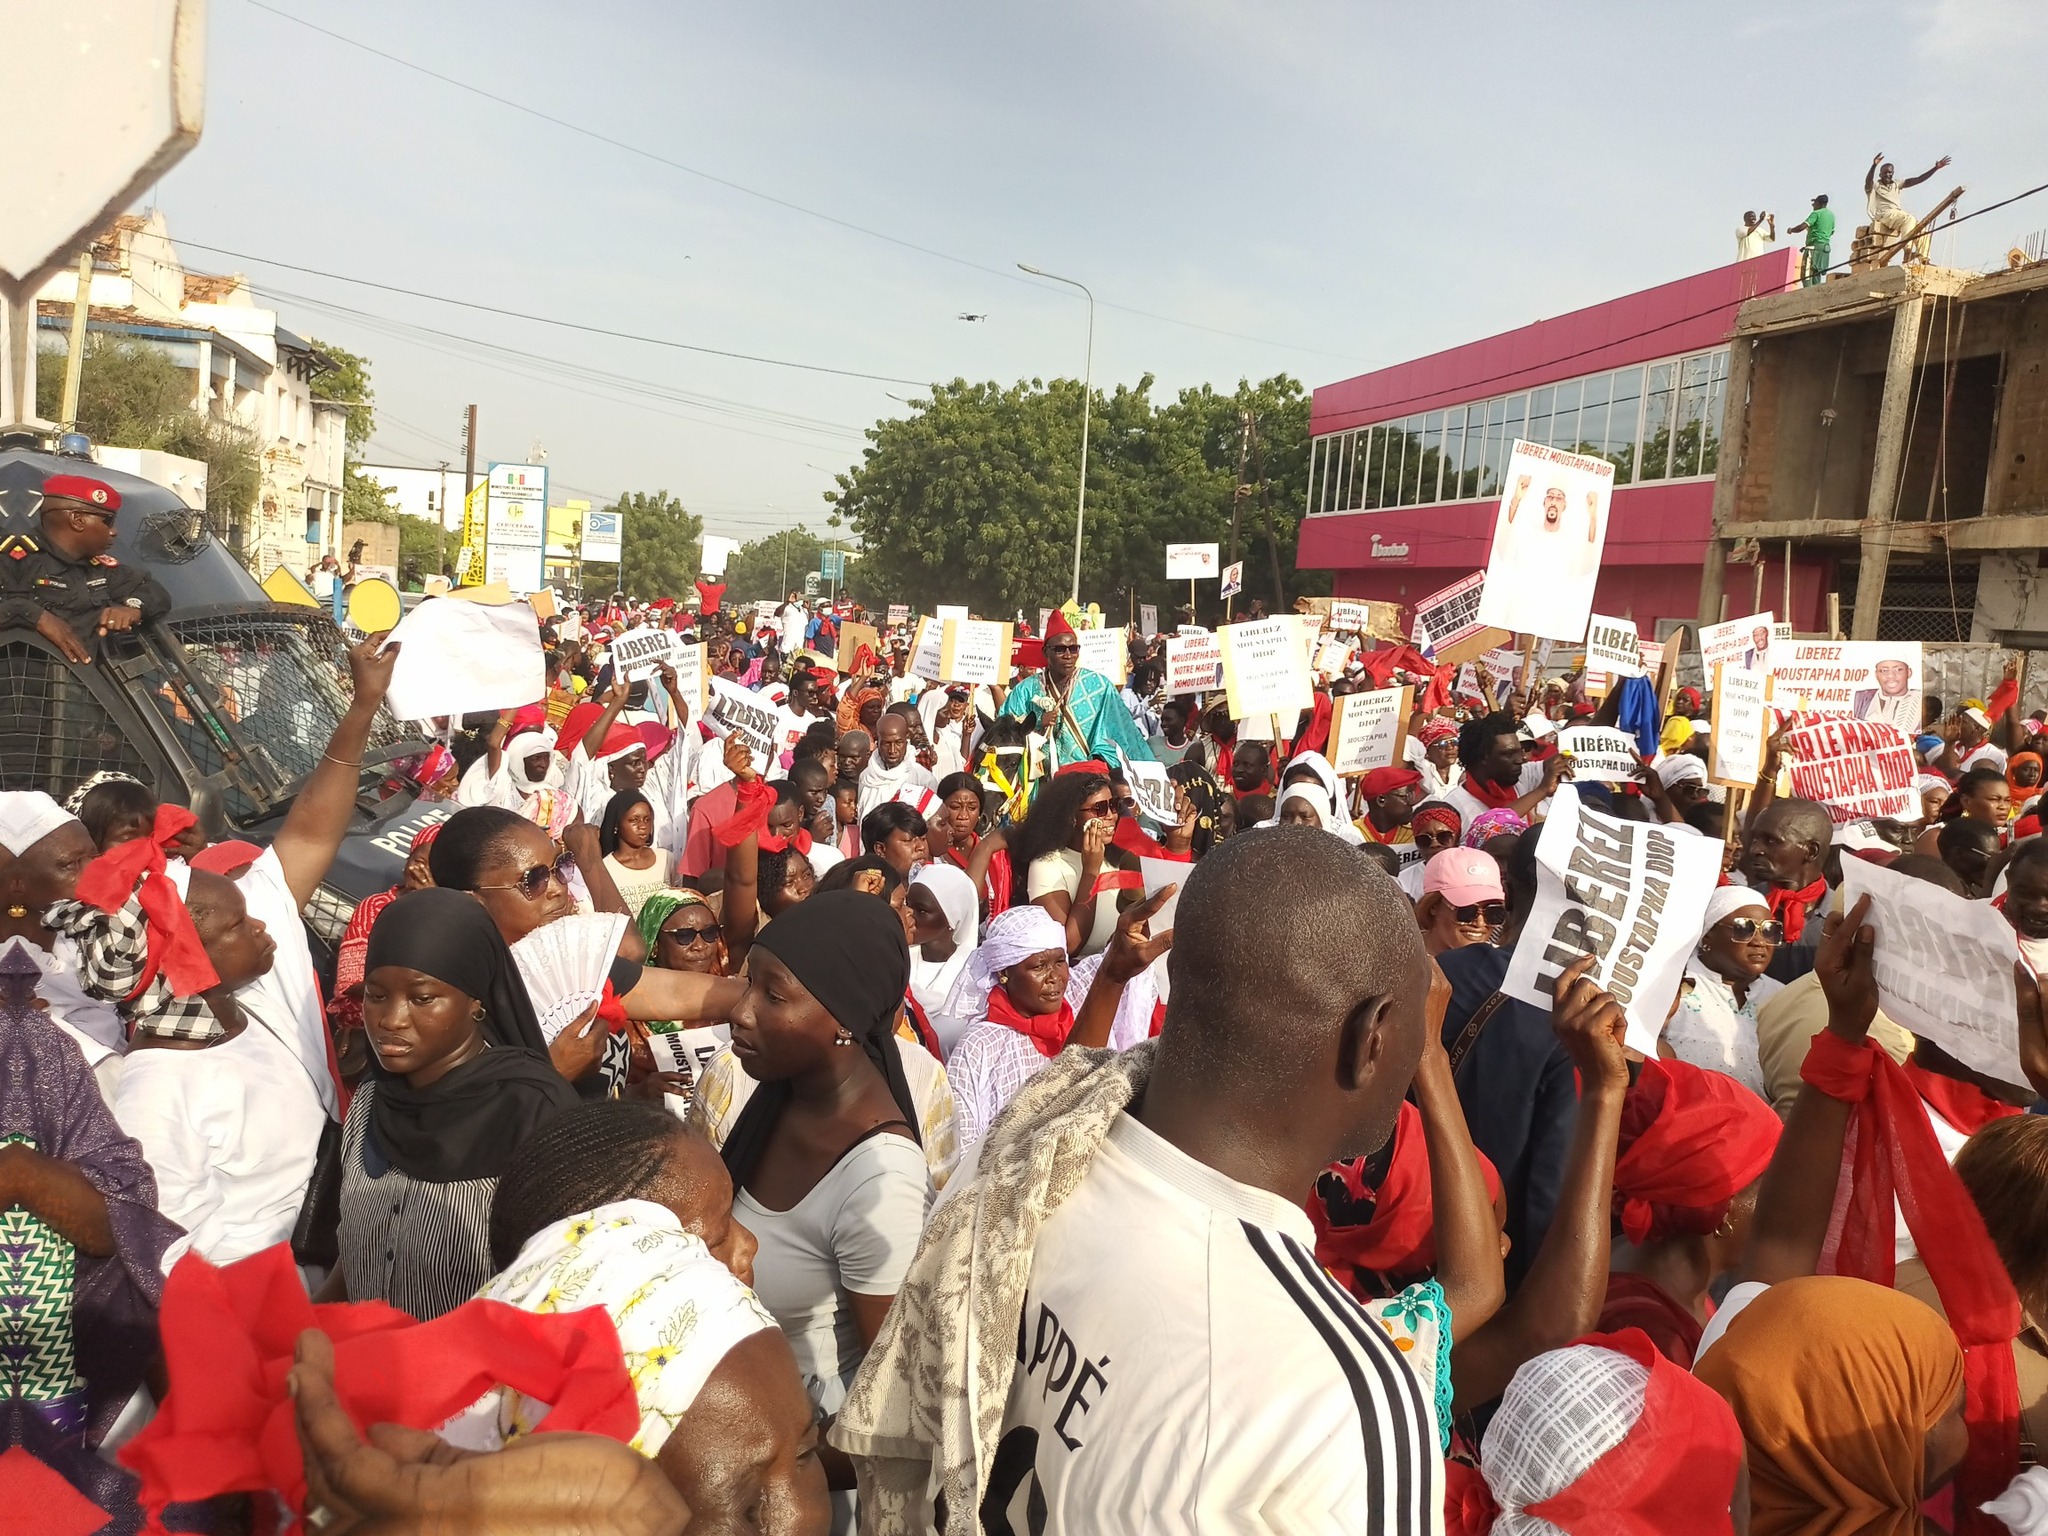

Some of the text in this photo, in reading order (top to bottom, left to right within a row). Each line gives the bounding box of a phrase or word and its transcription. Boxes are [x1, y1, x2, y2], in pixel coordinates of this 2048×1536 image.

[1515, 441, 1613, 477] LIBEREZ MOUSTAPHA DIOP
[616, 632, 671, 661] LIBEREZ
[1184, 637, 1210, 649] LIBEREZ
[1593, 626, 1640, 655] LIBER
[1171, 650, 1209, 663] MOUSTAPHA
[1593, 648, 1637, 665] MOUSTAPHA
[1795, 647, 1842, 660] LIBEREZ
[1174, 662, 1215, 676] NOTRE MAIRE
[1773, 667, 1869, 682] MOUSTAPHA DIOP
[1174, 675, 1216, 689] DOMOU LOUGA
[1353, 696, 1393, 708] LIBEREZ
[1815, 688, 1852, 702] MAIRE
[714, 693, 779, 739] LIBERE
[1358, 718, 1381, 728] DIOP
[1347, 732, 1388, 744] MOUSTAPHA
[1573, 735, 1629, 753] LIBÉREZ
[1814, 725, 1842, 760] LE
[1838, 722, 1905, 754] MAIRE
[1358, 745, 1374, 753] DIOP
[1569, 758, 1638, 772] OUSTAPHA DIO
[1790, 749, 1914, 802] MOUSTAPHA DIOP
[370, 808, 452, 859] POLICE
[638, 880, 669, 893] FRANCIS
[1606, 830, 1676, 1010] OUSTAPHA DIOP
[1017, 1289, 1111, 1452] PPÉ
